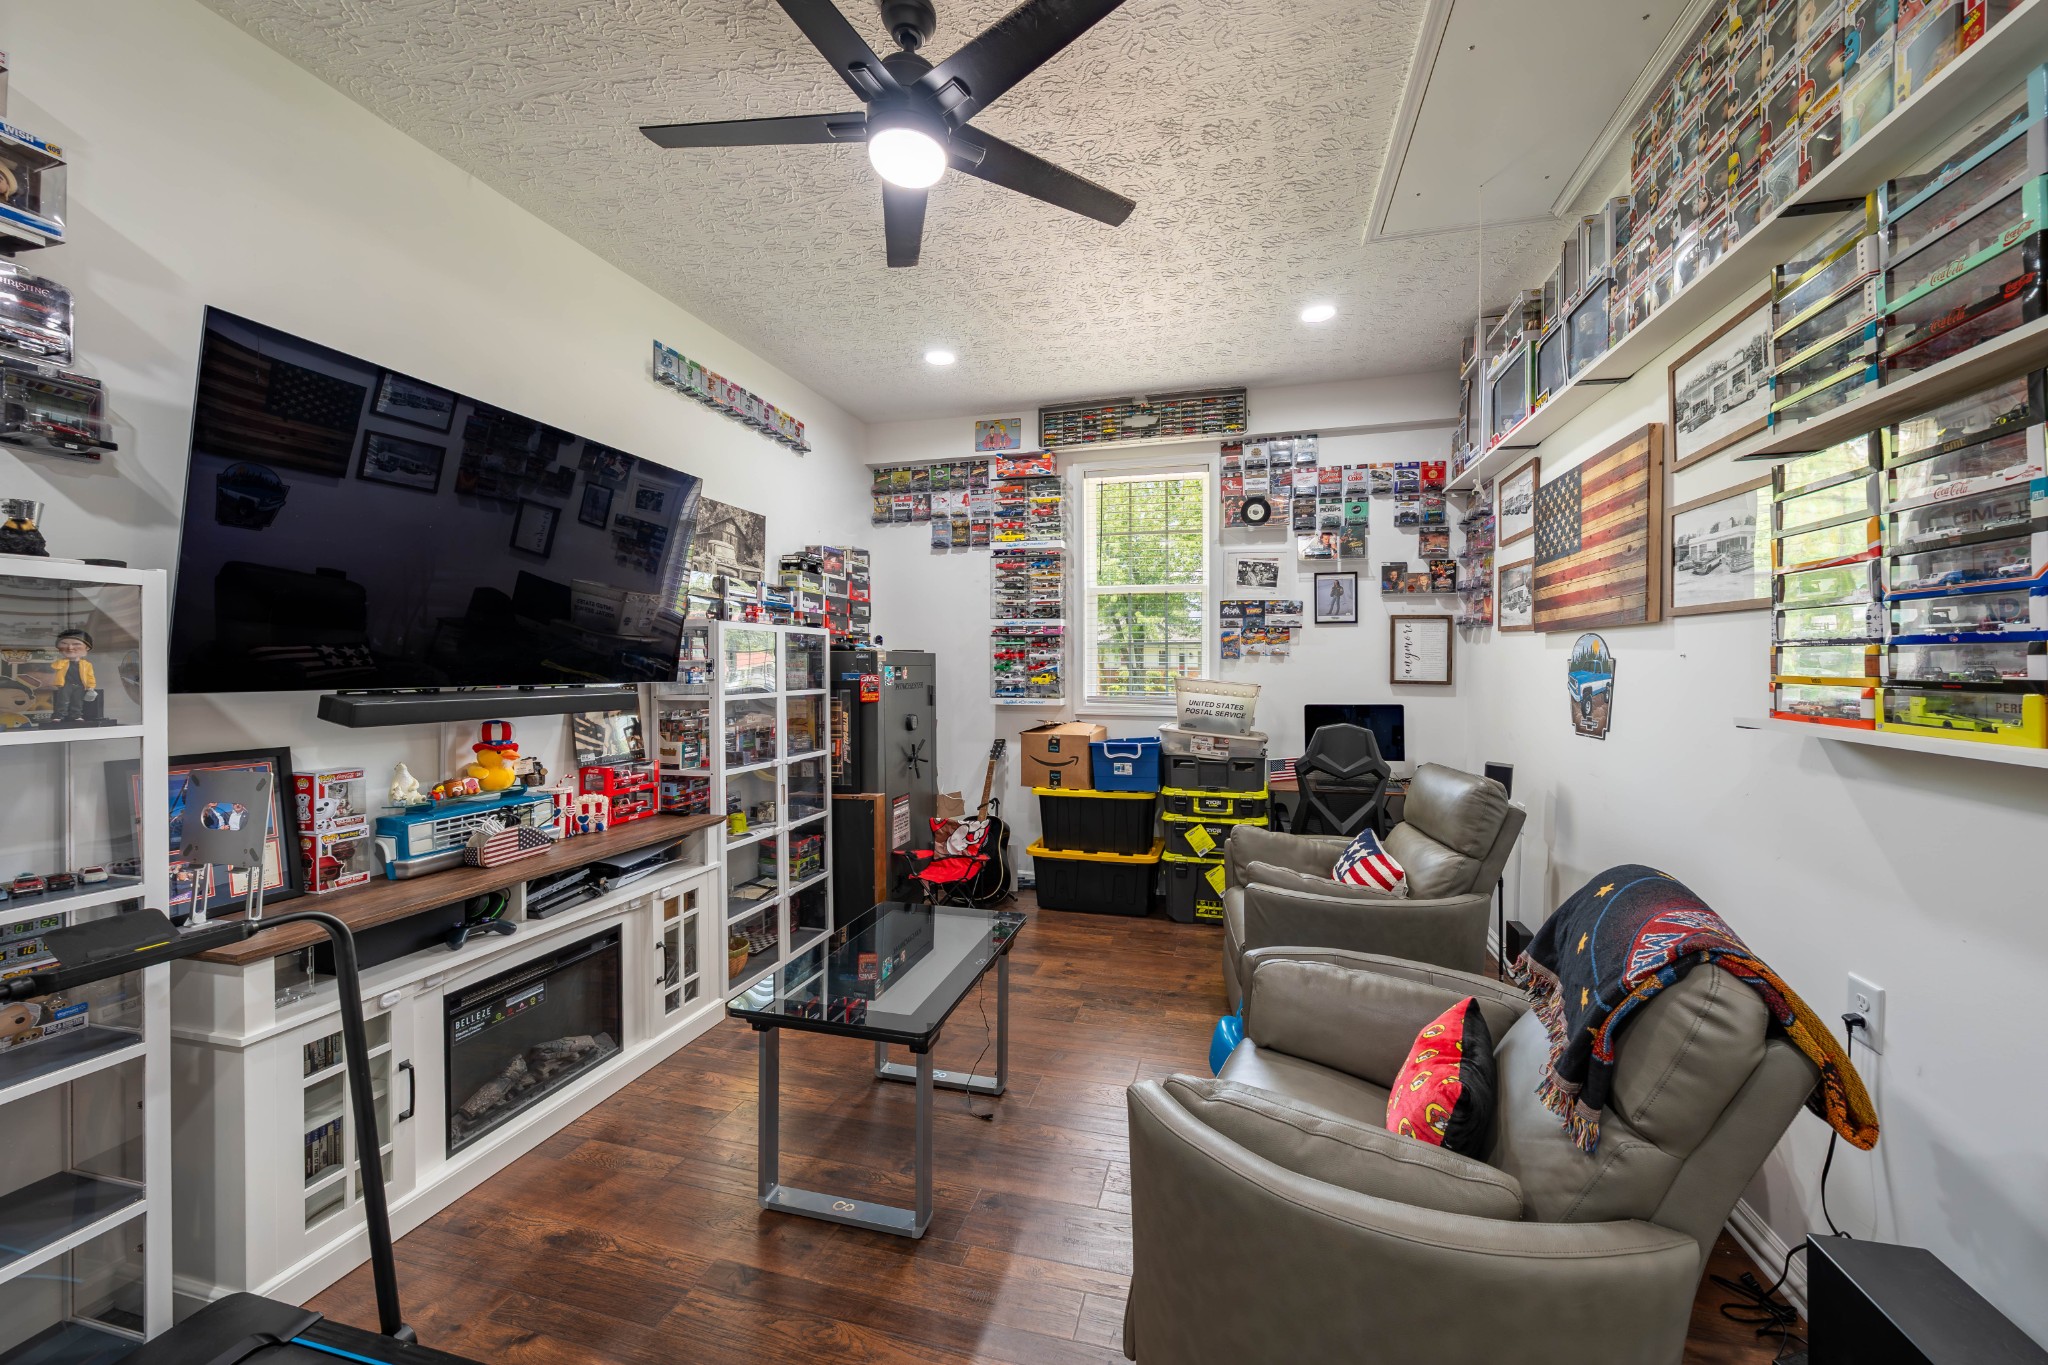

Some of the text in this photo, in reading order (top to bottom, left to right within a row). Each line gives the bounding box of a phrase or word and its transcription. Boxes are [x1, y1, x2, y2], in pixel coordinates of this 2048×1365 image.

[2, 124, 35, 143] WISH
[1930, 254, 1967, 286] Coca-Cola
[0, 276, 50, 297] HRISTINE
[1929, 303, 1968, 333] Coca-Cola
[1943, 437, 1967, 453] GMC
[1933, 479, 1973, 500] Coca-Cola
[1953, 501, 2012, 526] GMC
[895, 681, 924, 690] WINCHESTER
[1185, 707, 1247, 719] POSTAL SERVICE
[1188, 700, 1245, 711] UNITED STATES
[455, 1007, 492, 1030] BELLEZE
